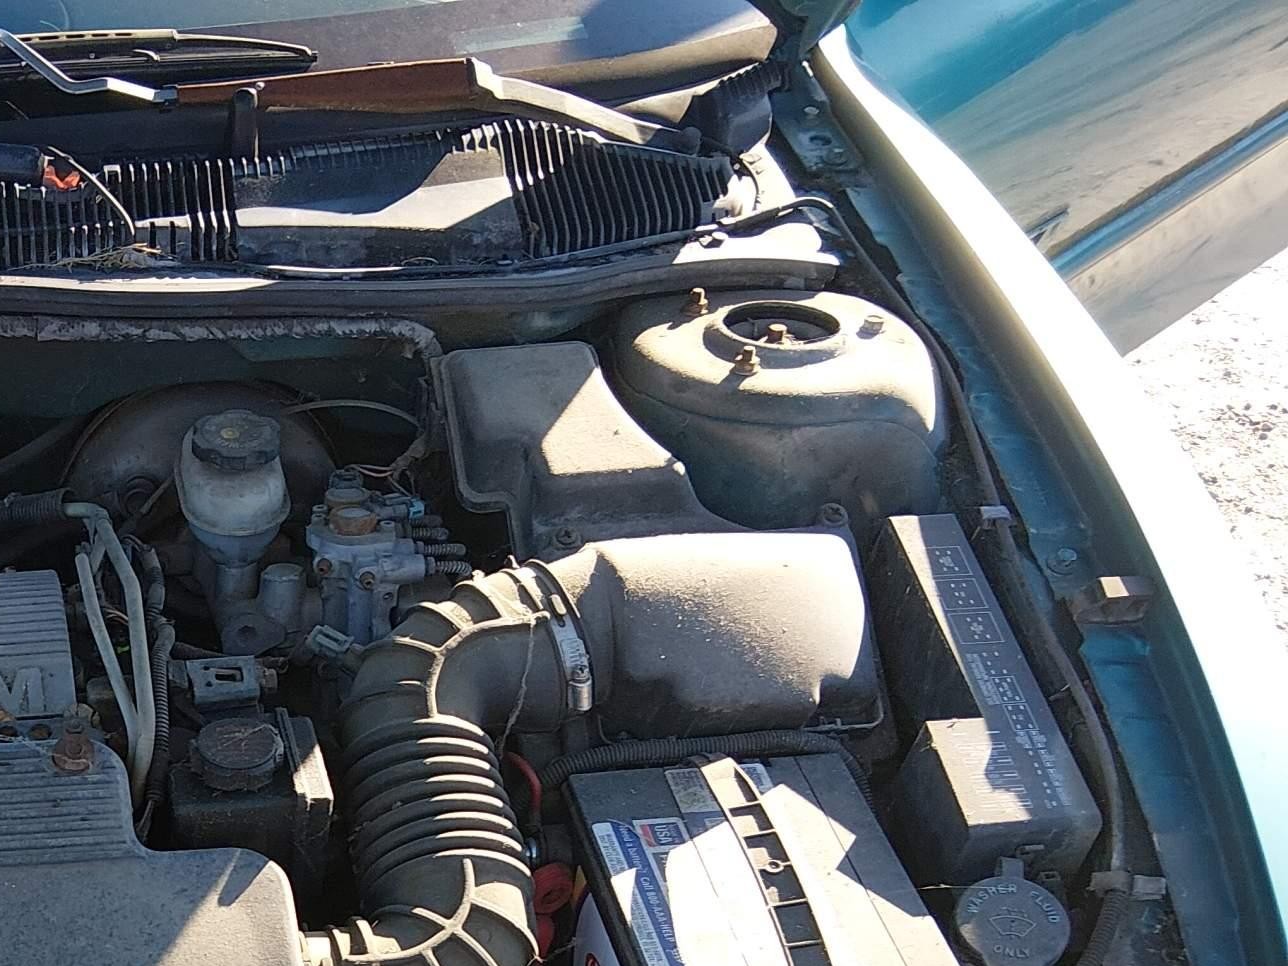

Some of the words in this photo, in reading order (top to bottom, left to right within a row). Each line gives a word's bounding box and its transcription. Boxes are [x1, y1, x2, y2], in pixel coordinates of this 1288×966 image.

[654, 824, 672, 844] USA
[640, 876, 654, 890] Call
[967, 884, 1017, 913] WASHER
[1031, 891, 1060, 923] FLUID
[993, 945, 1030, 958] ONLY
